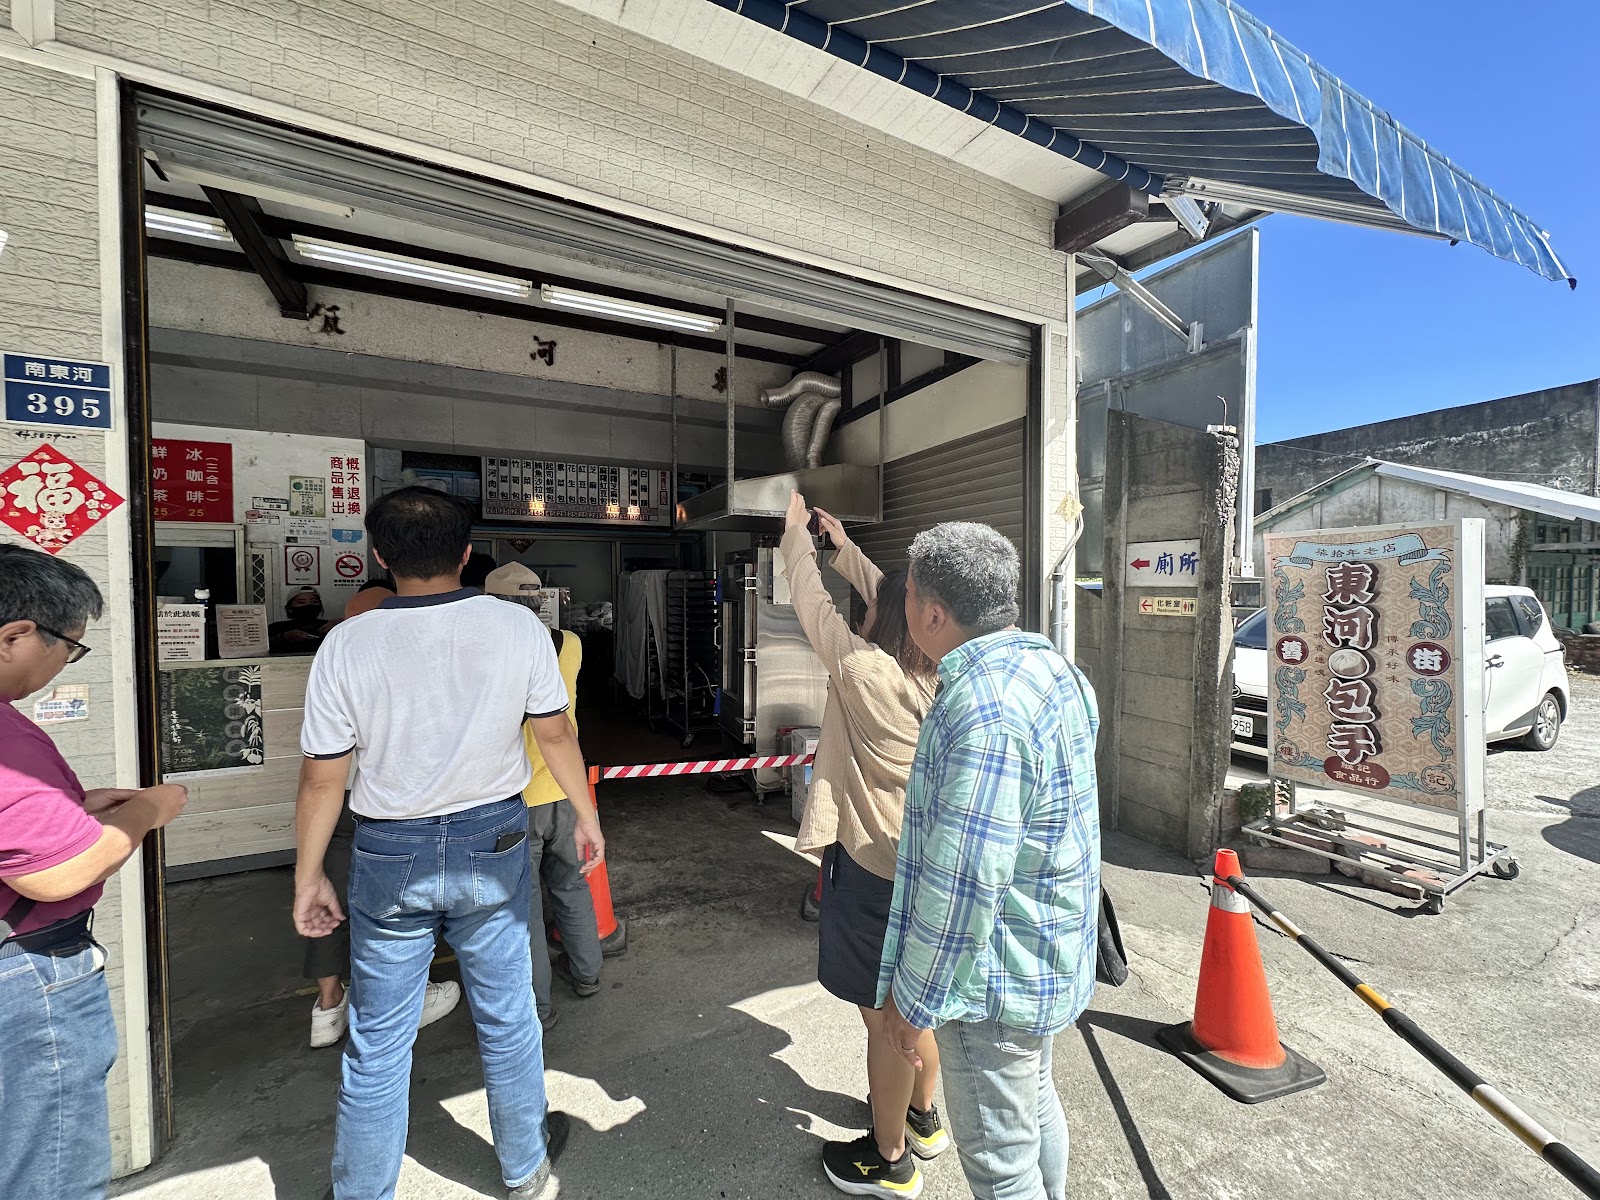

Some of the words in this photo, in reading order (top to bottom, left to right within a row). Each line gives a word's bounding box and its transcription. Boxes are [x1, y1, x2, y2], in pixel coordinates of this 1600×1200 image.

[25, 361, 94, 383] 南東河
[27, 393, 101, 419] 395
[7, 462, 86, 515] 福
[185, 448, 204, 503] 冰咖啡
[330, 456, 345, 514] 商品售出
[346, 457, 361, 515] 概不退換
[487, 458, 497, 498] 東河肉包
[511, 460, 521, 499] 竹筍包
[523, 461, 532, 501] 泡菜包
[578, 465, 586, 504] 紅豆包
[188, 508, 205, 517] 25
[1154, 551, 1200, 576] 廁所
[1332, 770, 1380, 787] 食品行
[1428, 773, 1448, 787] 記
